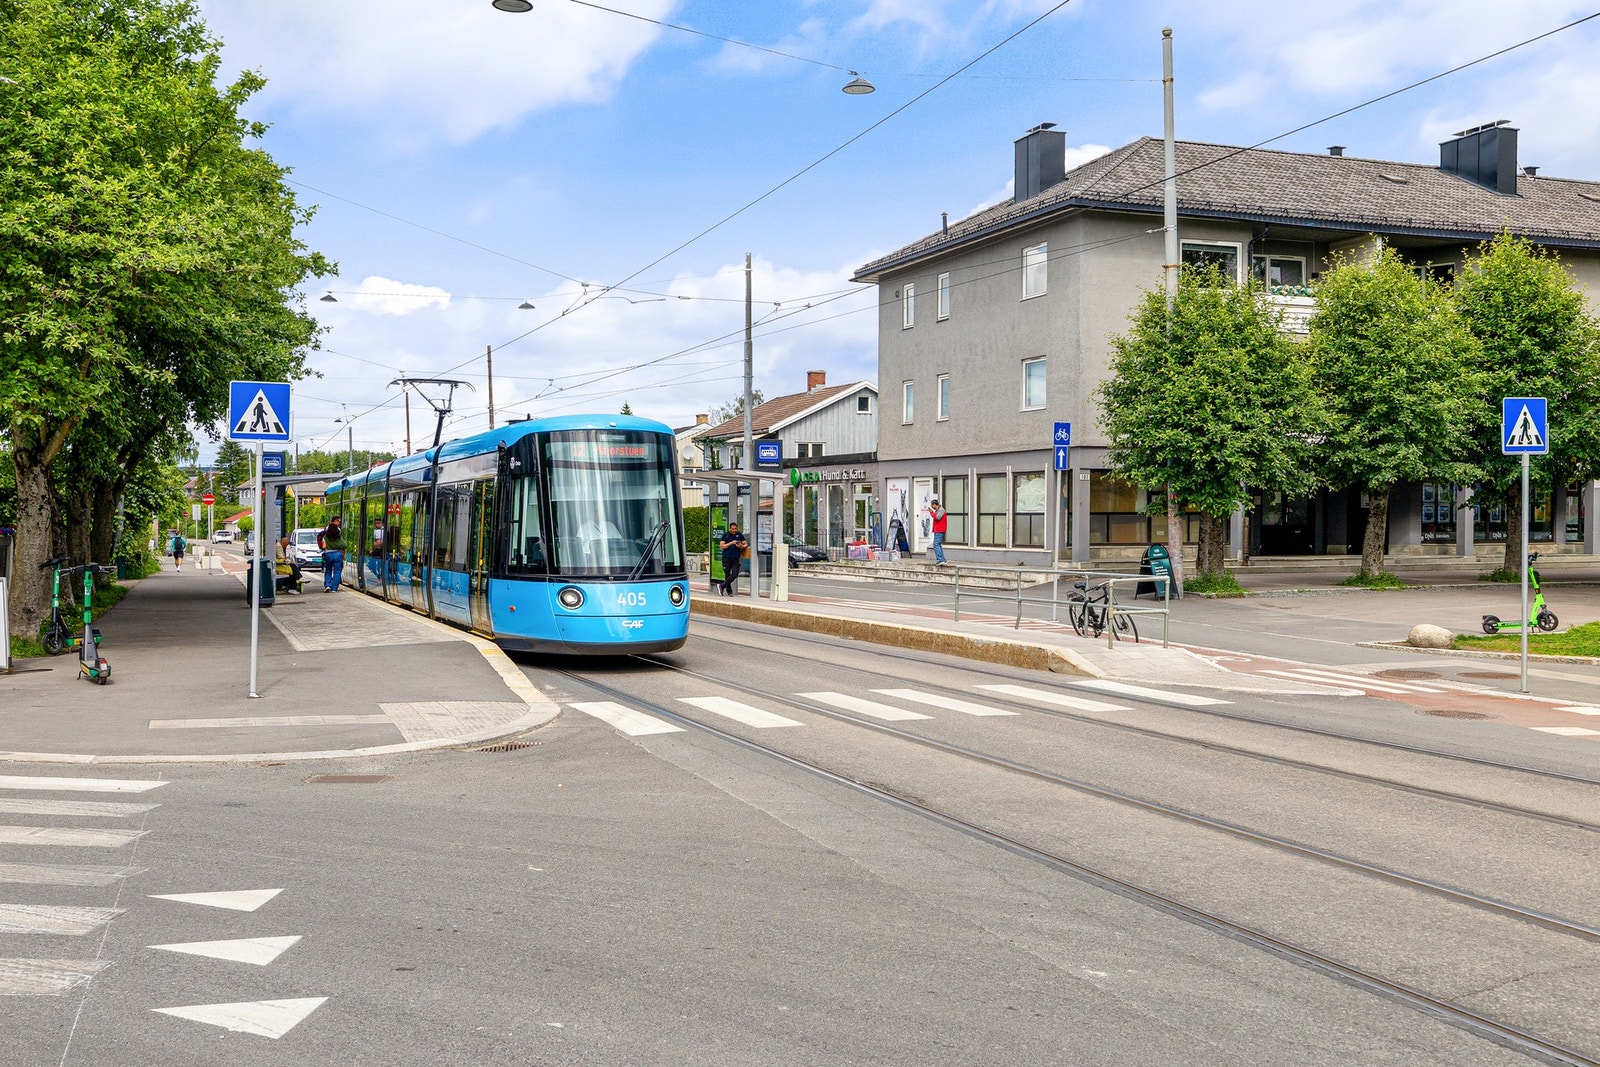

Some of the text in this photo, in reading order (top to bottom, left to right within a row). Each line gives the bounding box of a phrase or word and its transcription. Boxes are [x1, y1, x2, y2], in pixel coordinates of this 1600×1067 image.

[822, 470, 840, 480] Hund
[842, 469, 849, 479] &
[850, 468, 864, 479] Katt
[617, 592, 647, 606] 405
[622, 620, 644, 629] CAF
